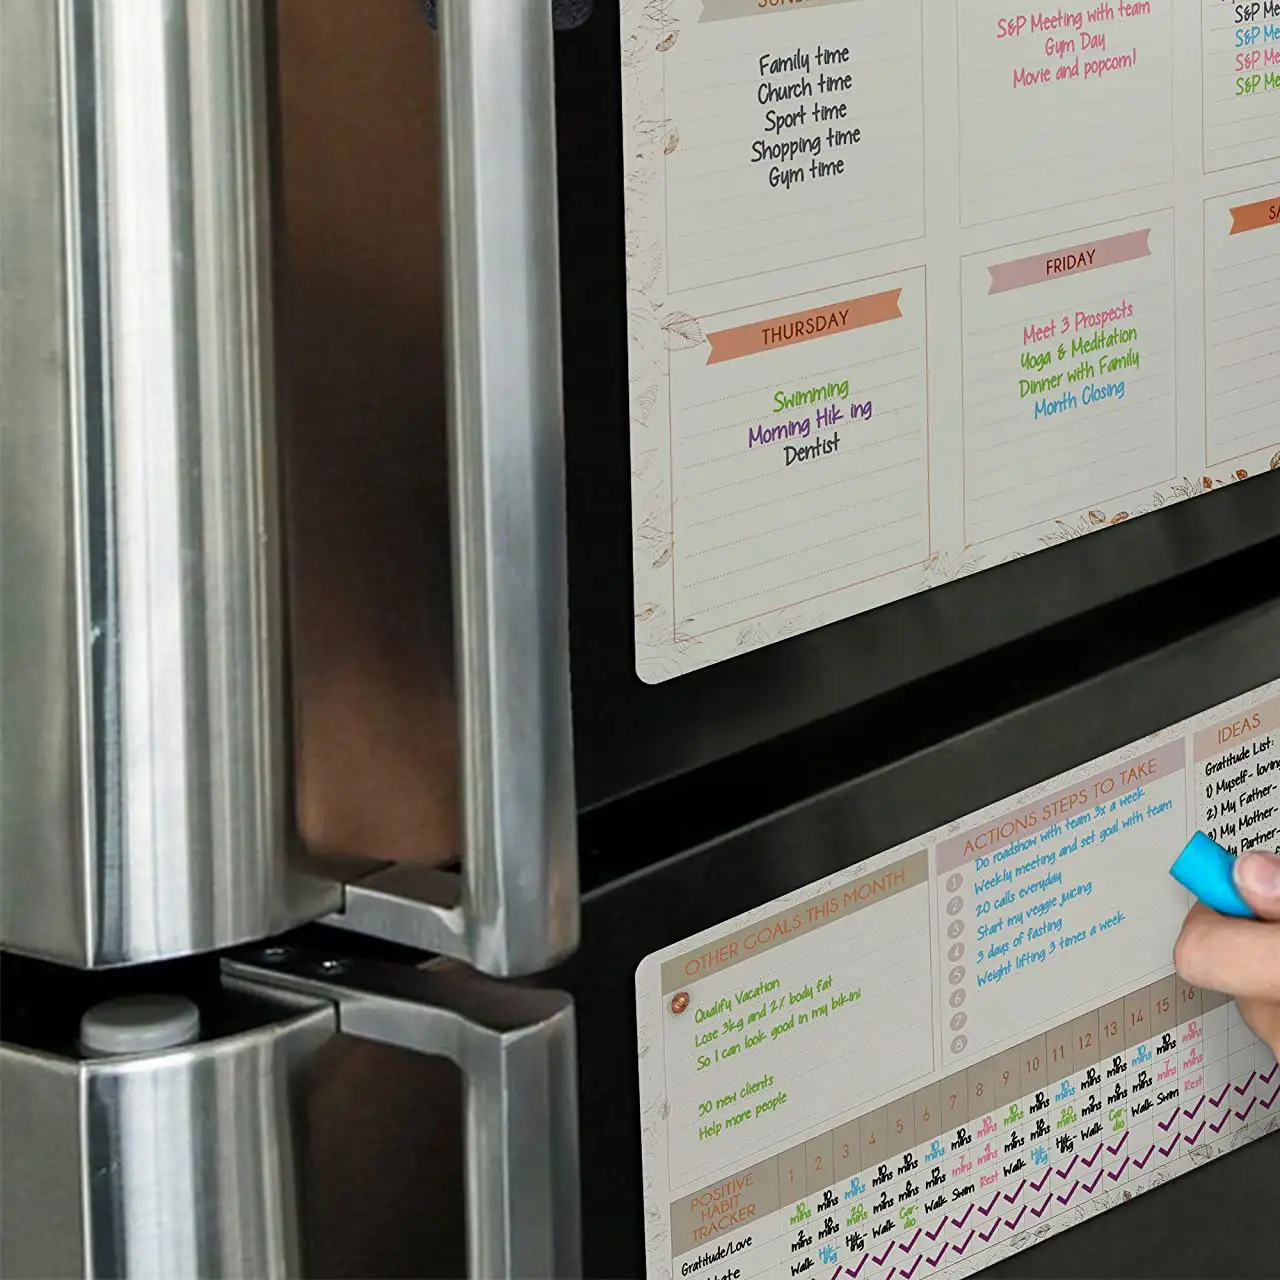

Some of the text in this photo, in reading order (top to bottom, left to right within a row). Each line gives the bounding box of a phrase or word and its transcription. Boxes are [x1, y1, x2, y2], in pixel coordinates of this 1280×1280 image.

[760, 46, 849, 76] Family time
[758, 74, 852, 104] Church time
[765, 102, 846, 135] Sport time
[751, 128, 860, 162] Shopping time
[769, 159, 844, 189] Gym time
[1047, 249, 1095, 275] FRIDAY
[762, 309, 849, 345] THURSDAY
[1035, 381, 1124, 419] Month Closing
[1219, 712, 1260, 744] IDEAS
[1205, 746, 1250, 776] Gratitude
[963, 758, 1156, 856] ACTIONS STEPS TO TAKE
[976, 872, 1062, 917] 20 calls everyday
[685, 868, 904, 976] OTHER GOALS THIS MONTH
[695, 979, 780, 1023] Qualify Vacation
[691, 1173, 754, 1212] POSITIVE
[701, 1193, 741, 1222] HABIT
[692, 1204, 756, 1241] TRACKER
